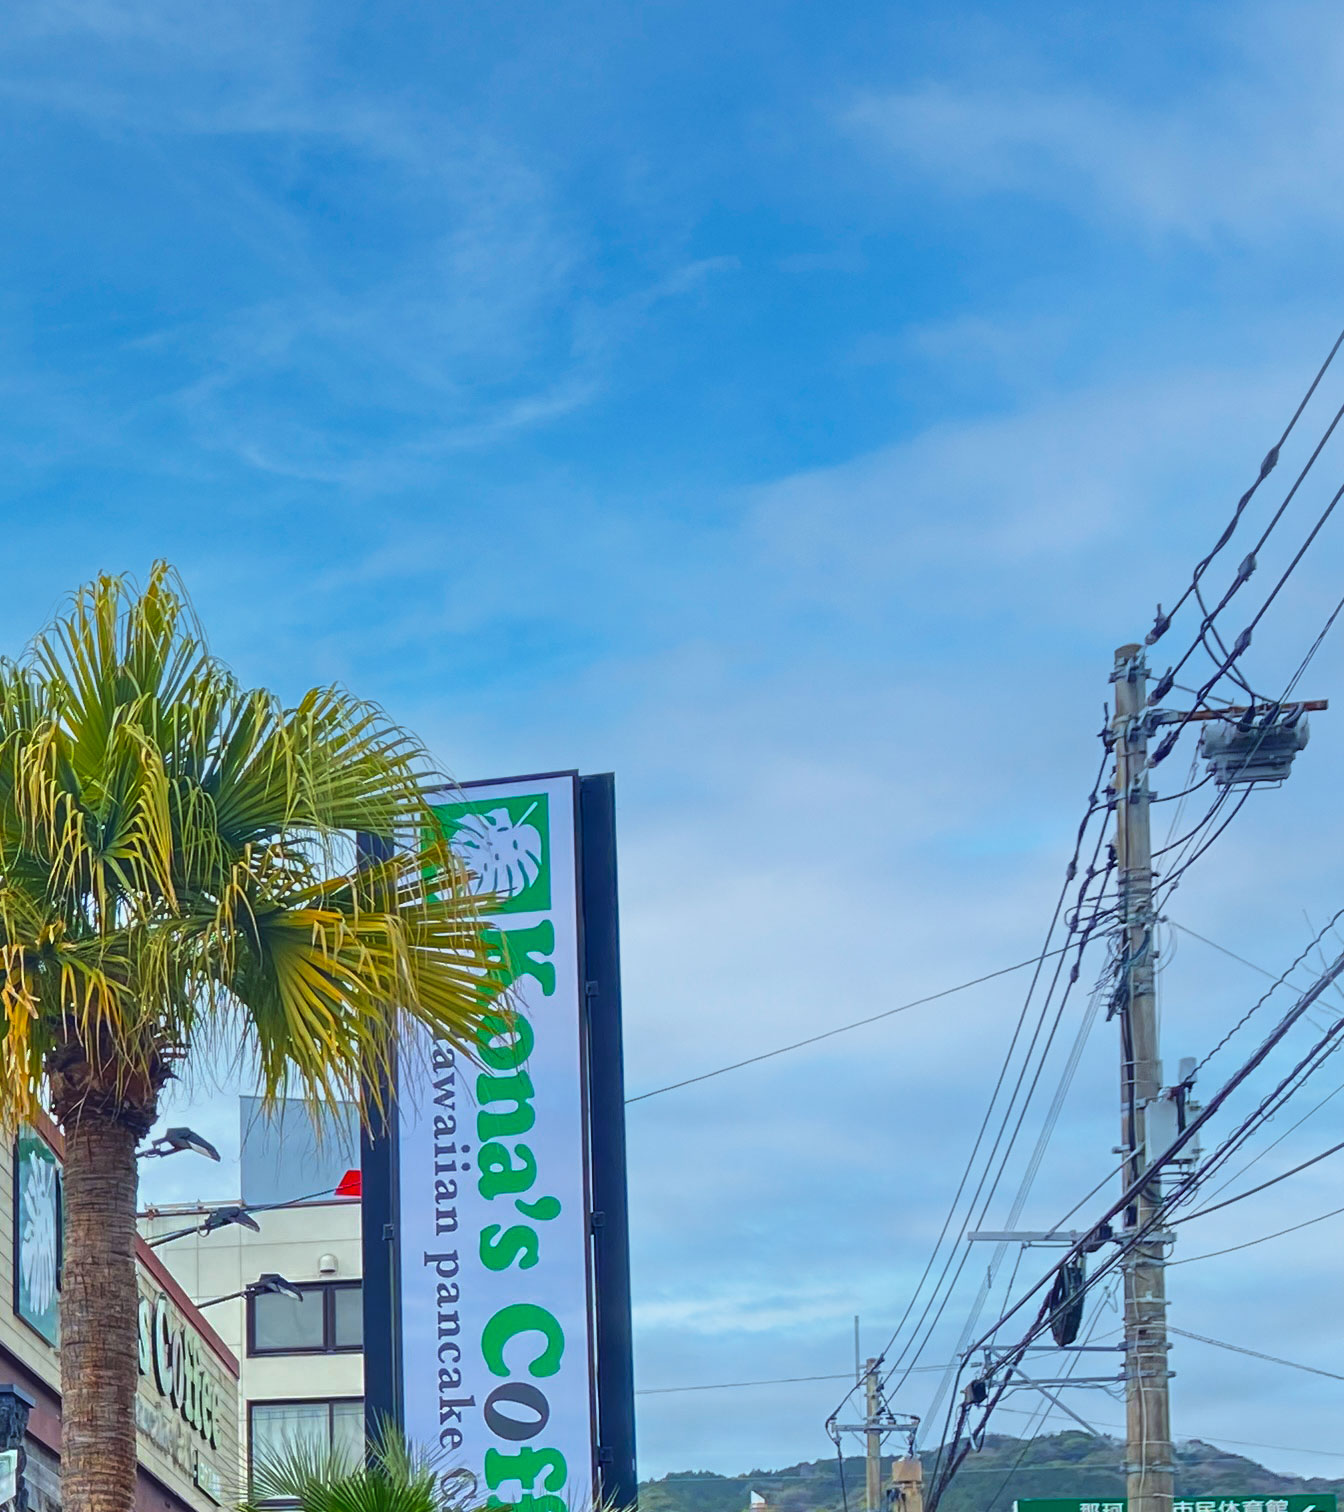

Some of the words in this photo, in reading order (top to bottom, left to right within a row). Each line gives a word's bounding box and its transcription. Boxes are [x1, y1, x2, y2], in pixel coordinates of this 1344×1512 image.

[432, 1037, 471, 1236] awaiian
[476, 919, 561, 1271] Kona's
[424, 1250, 475, 1450] pancake
